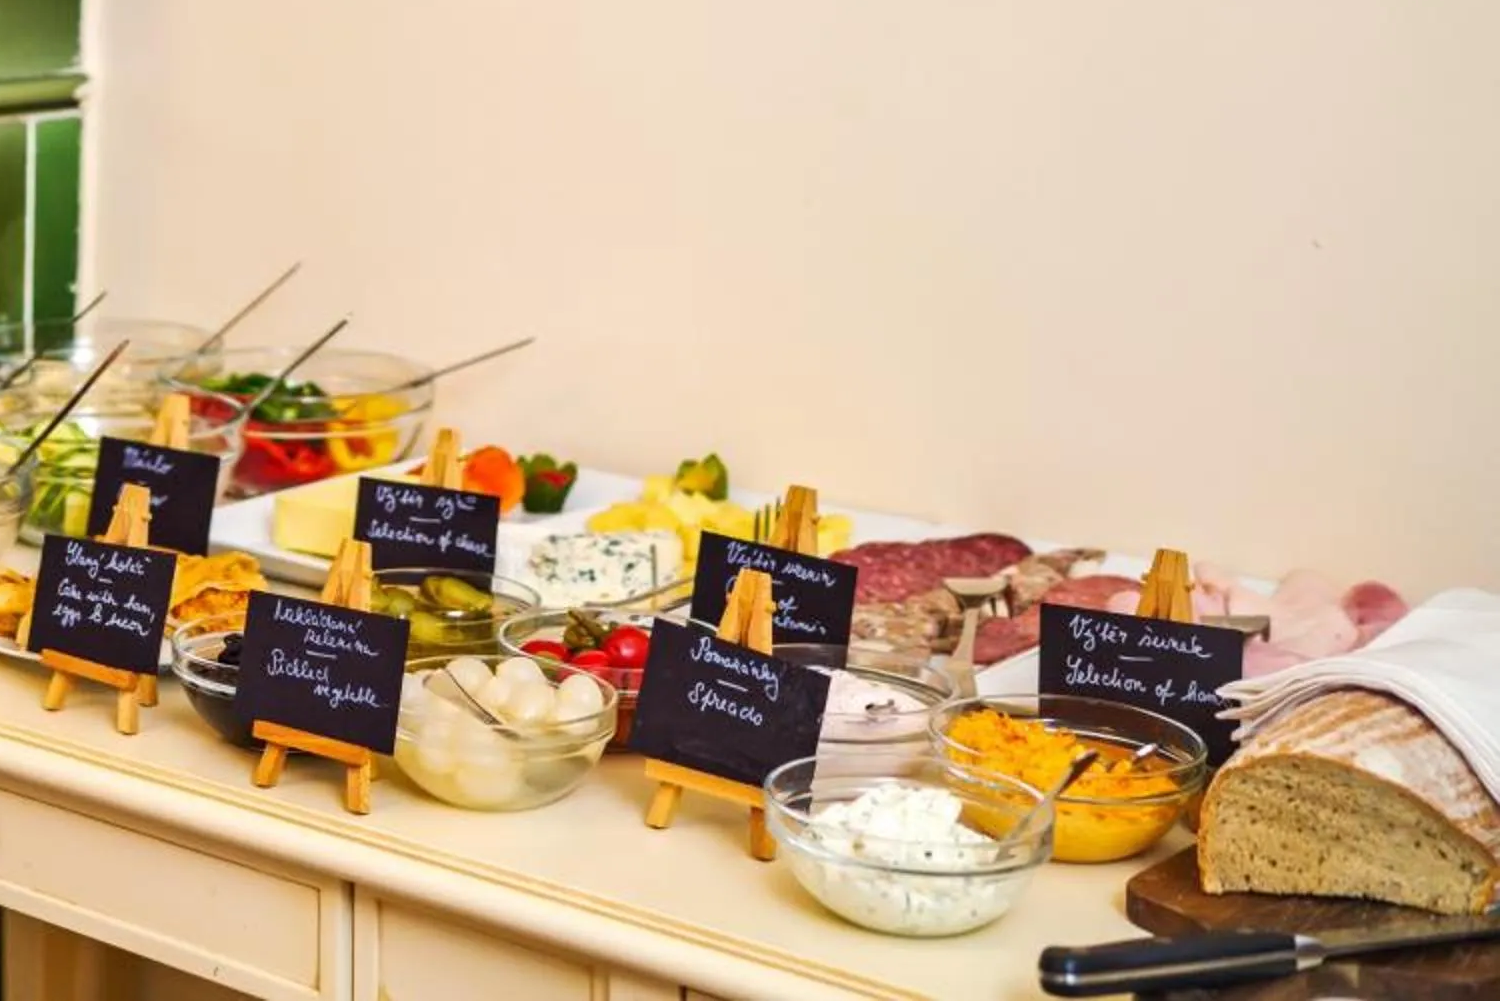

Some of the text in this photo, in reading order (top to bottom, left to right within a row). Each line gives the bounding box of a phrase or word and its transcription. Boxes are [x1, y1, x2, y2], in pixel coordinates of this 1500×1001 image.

[367, 519, 435, 546] Selection
[439, 530, 452, 553] of
[86, 590, 118, 606] with
[267, 648, 330, 683] Pickled
[1065, 654, 1147, 693] Selection
[1155, 679, 1176, 706] of
[313, 683, 383, 709] vegetable
